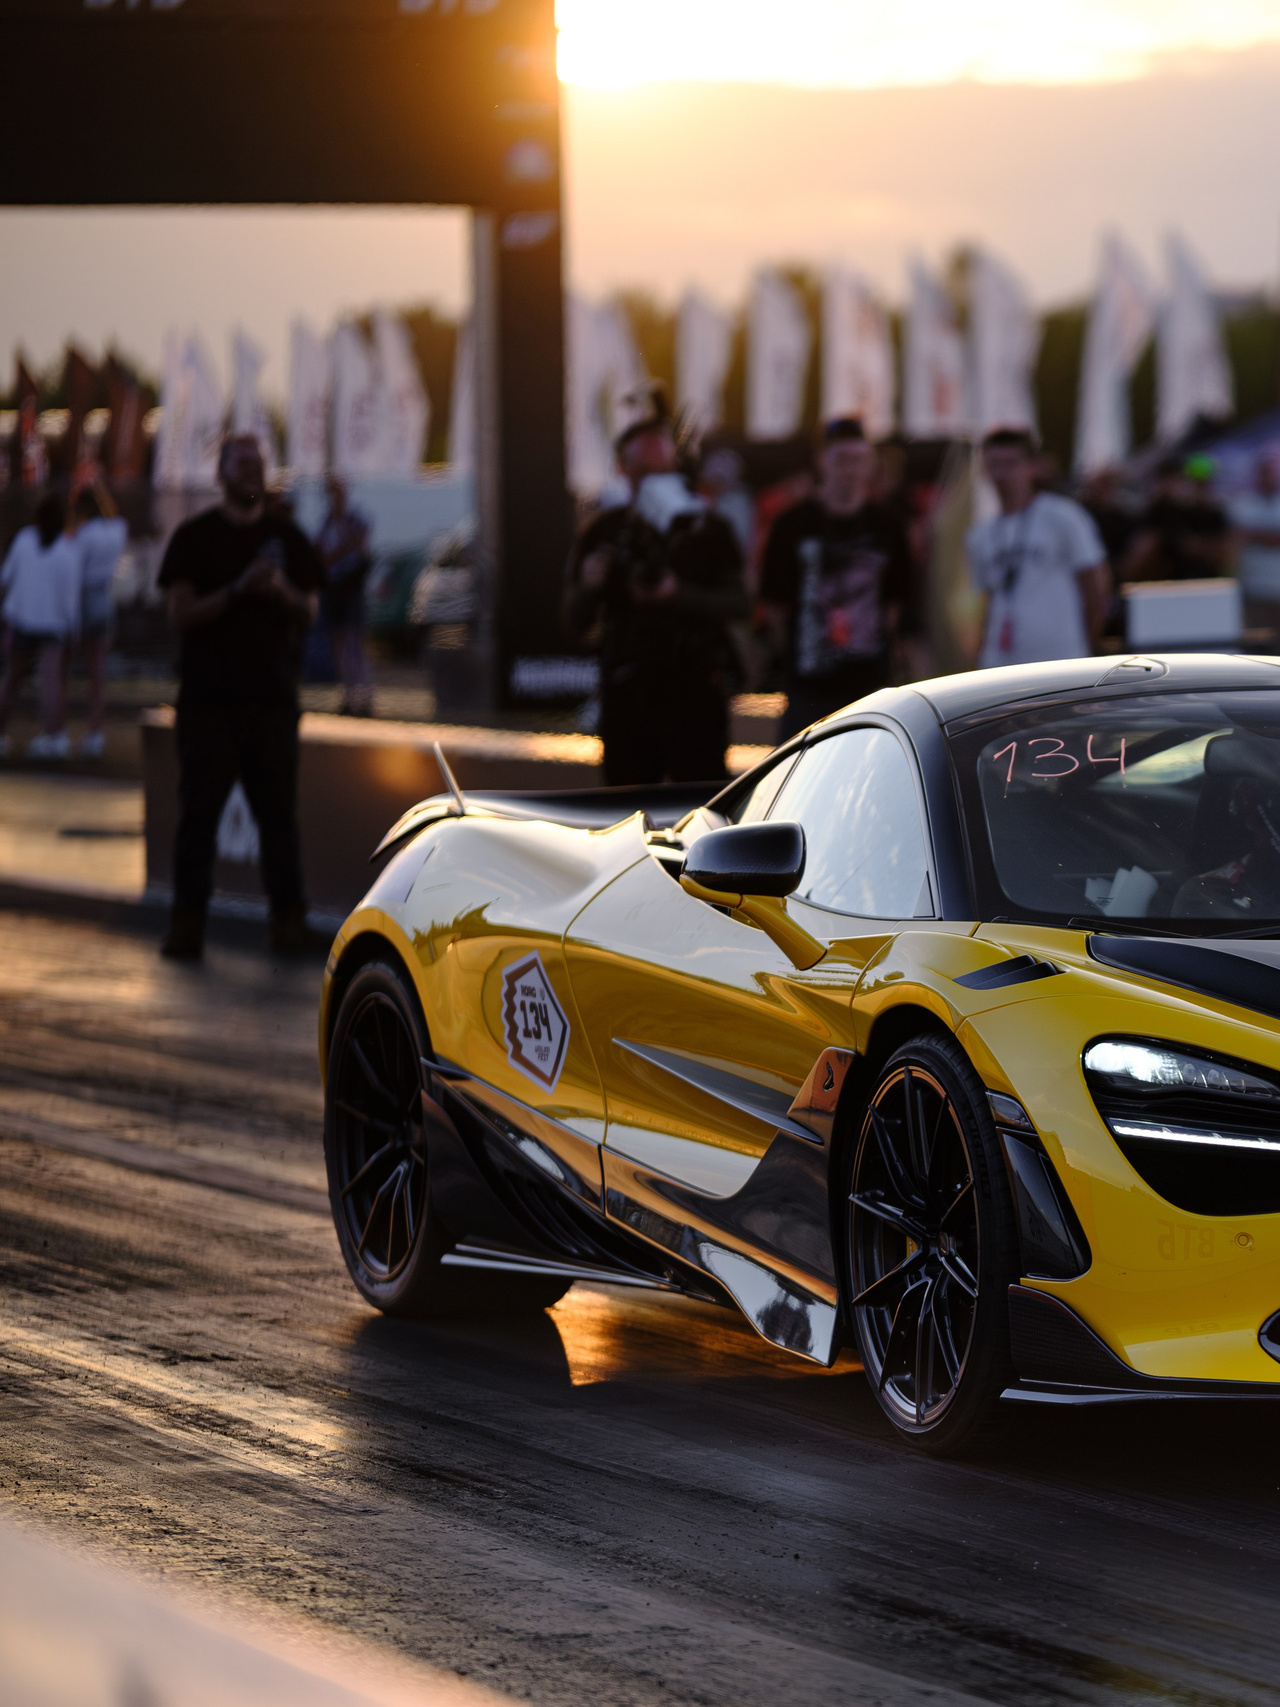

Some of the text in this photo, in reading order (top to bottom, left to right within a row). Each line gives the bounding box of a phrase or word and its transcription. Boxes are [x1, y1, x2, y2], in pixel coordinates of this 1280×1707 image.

[993, 734, 1126, 782] 134
[520, 999, 552, 1042] 134
[537, 1052, 550, 1062] FEST
